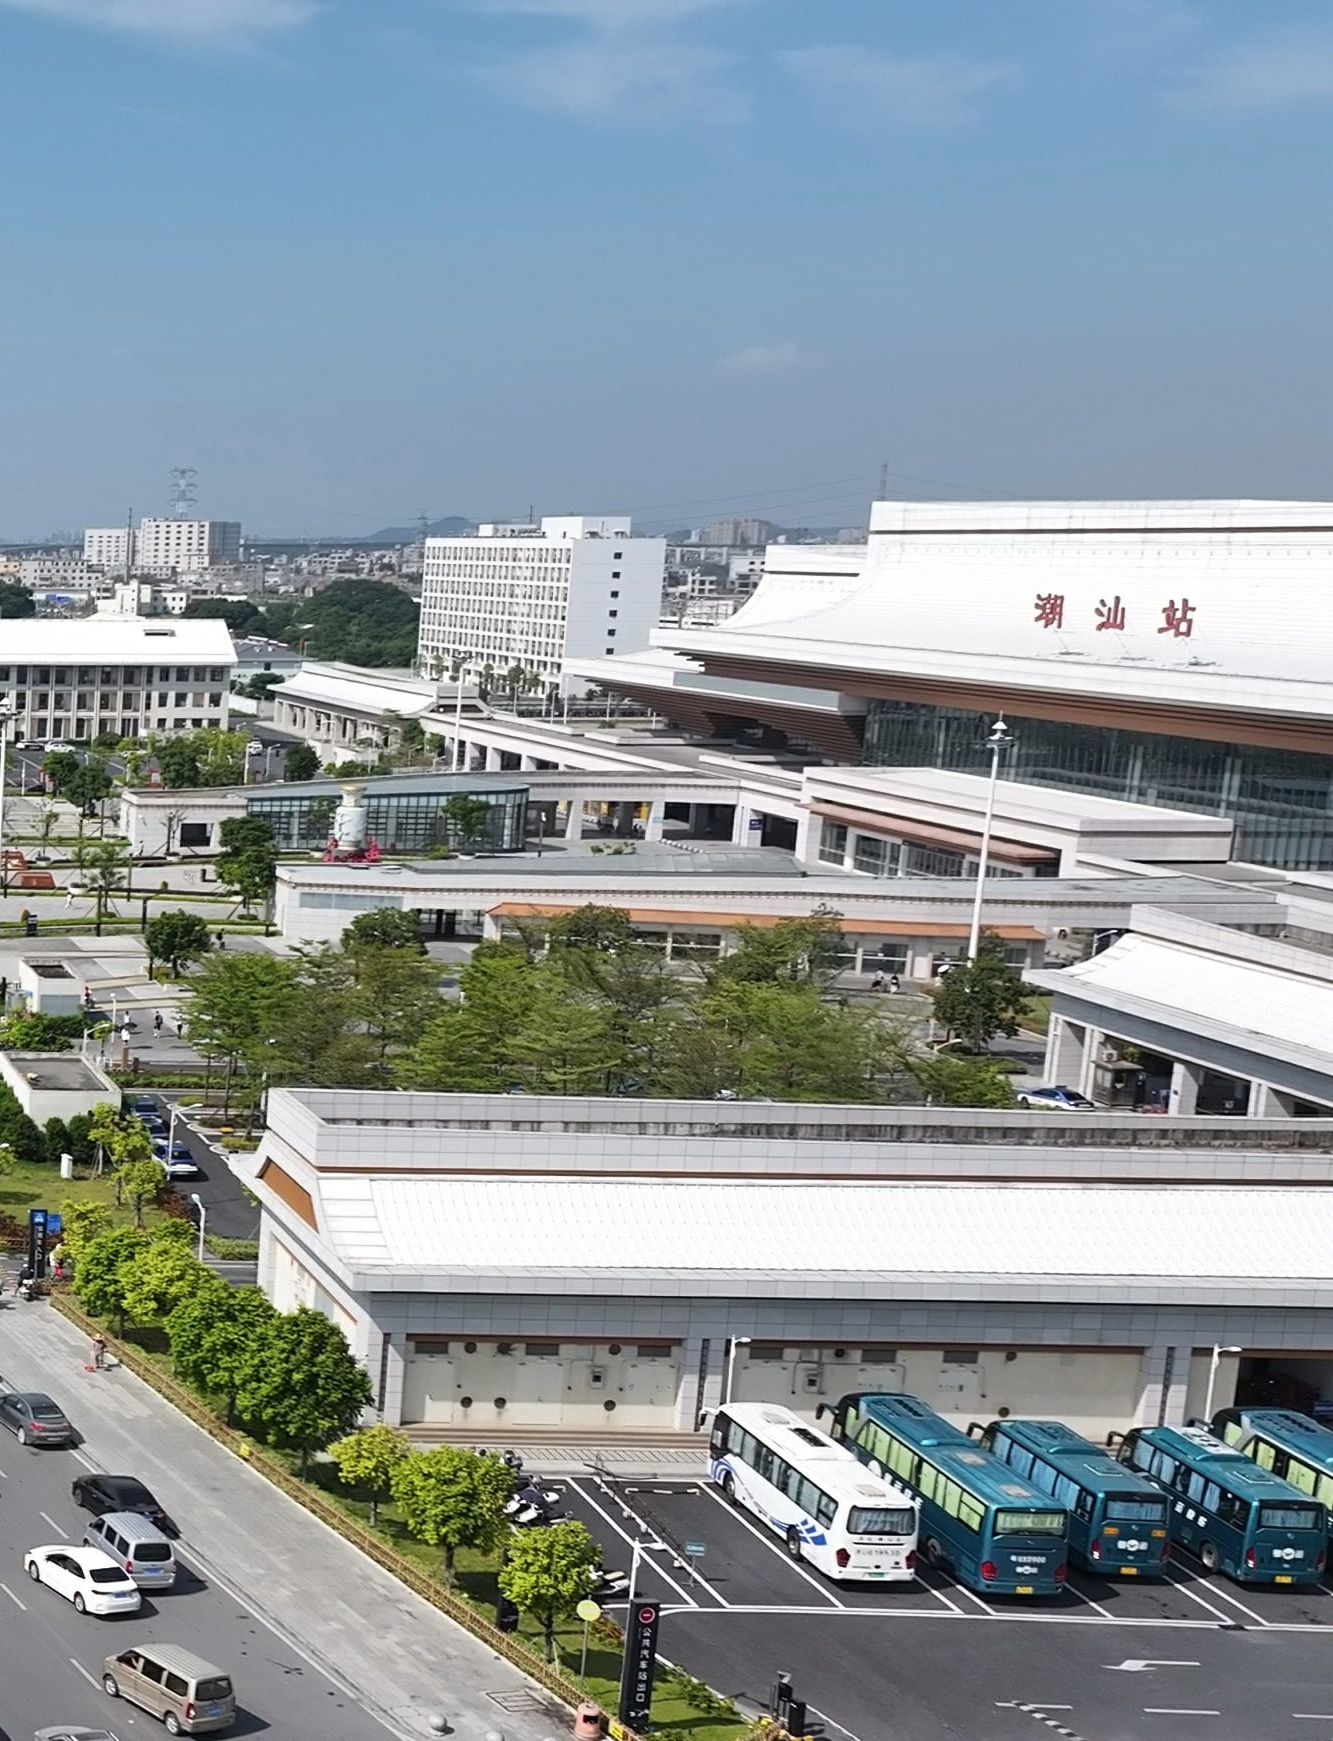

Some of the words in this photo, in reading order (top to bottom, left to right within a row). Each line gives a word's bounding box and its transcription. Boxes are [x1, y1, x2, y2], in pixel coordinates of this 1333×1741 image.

[1034, 592, 1197, 638] 潮汕站
[635, 1627, 652, 1702] 公共汽车站出口
